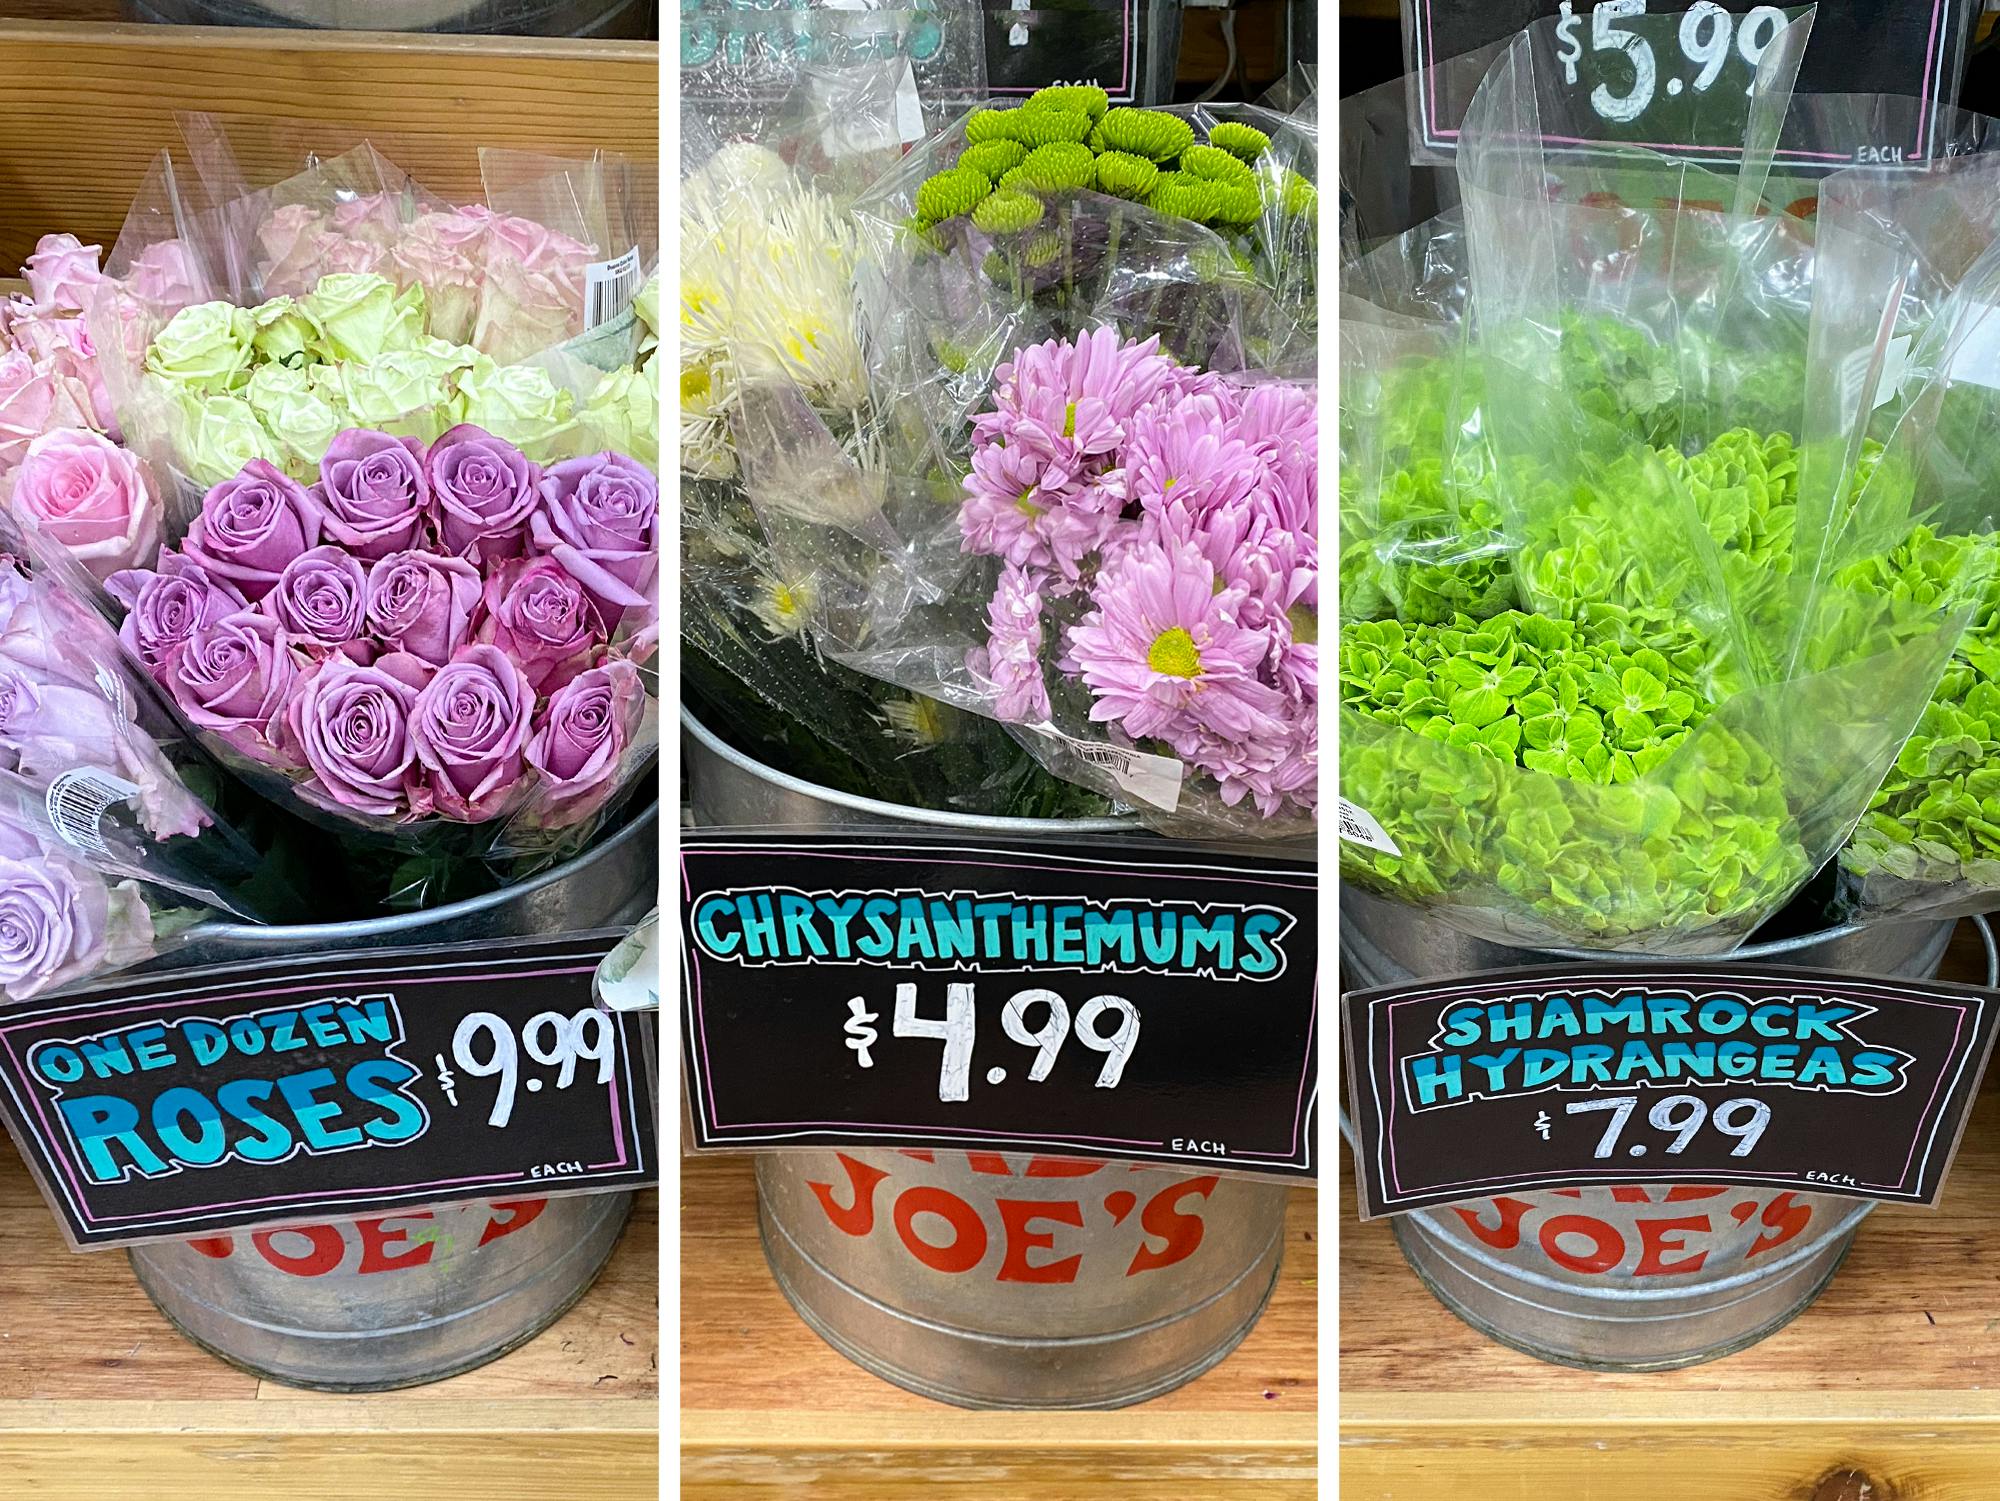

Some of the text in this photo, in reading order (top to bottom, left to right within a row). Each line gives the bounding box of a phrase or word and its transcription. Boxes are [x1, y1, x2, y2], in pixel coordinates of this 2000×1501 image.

[1556, 0, 1788, 122] $5.99
[1857, 145, 1903, 164] EACH
[697, 892, 1282, 974] CHRYSANTHEMUMS
[38, 1000, 393, 1083] ONE DOZEN
[843, 982, 1141, 1102] $4.99
[1443, 995, 1858, 1048] SHAMROCK
[436, 1007, 616, 1128] $9.99
[1411, 1039, 1898, 1106] HYDRANGEAS
[57, 1060, 421, 1182] ROSES
[1171, 1138, 1227, 1156] EACH
[1533, 1095, 1774, 1159] $7.99
[530, 1161, 584, 1178] EACH
[1804, 1170, 1856, 1187] EACH
[186, 1199, 549, 1278] OES
[806, 1152, 1221, 1285] JOE'S
[1449, 1191, 1813, 1277] JOE'S
